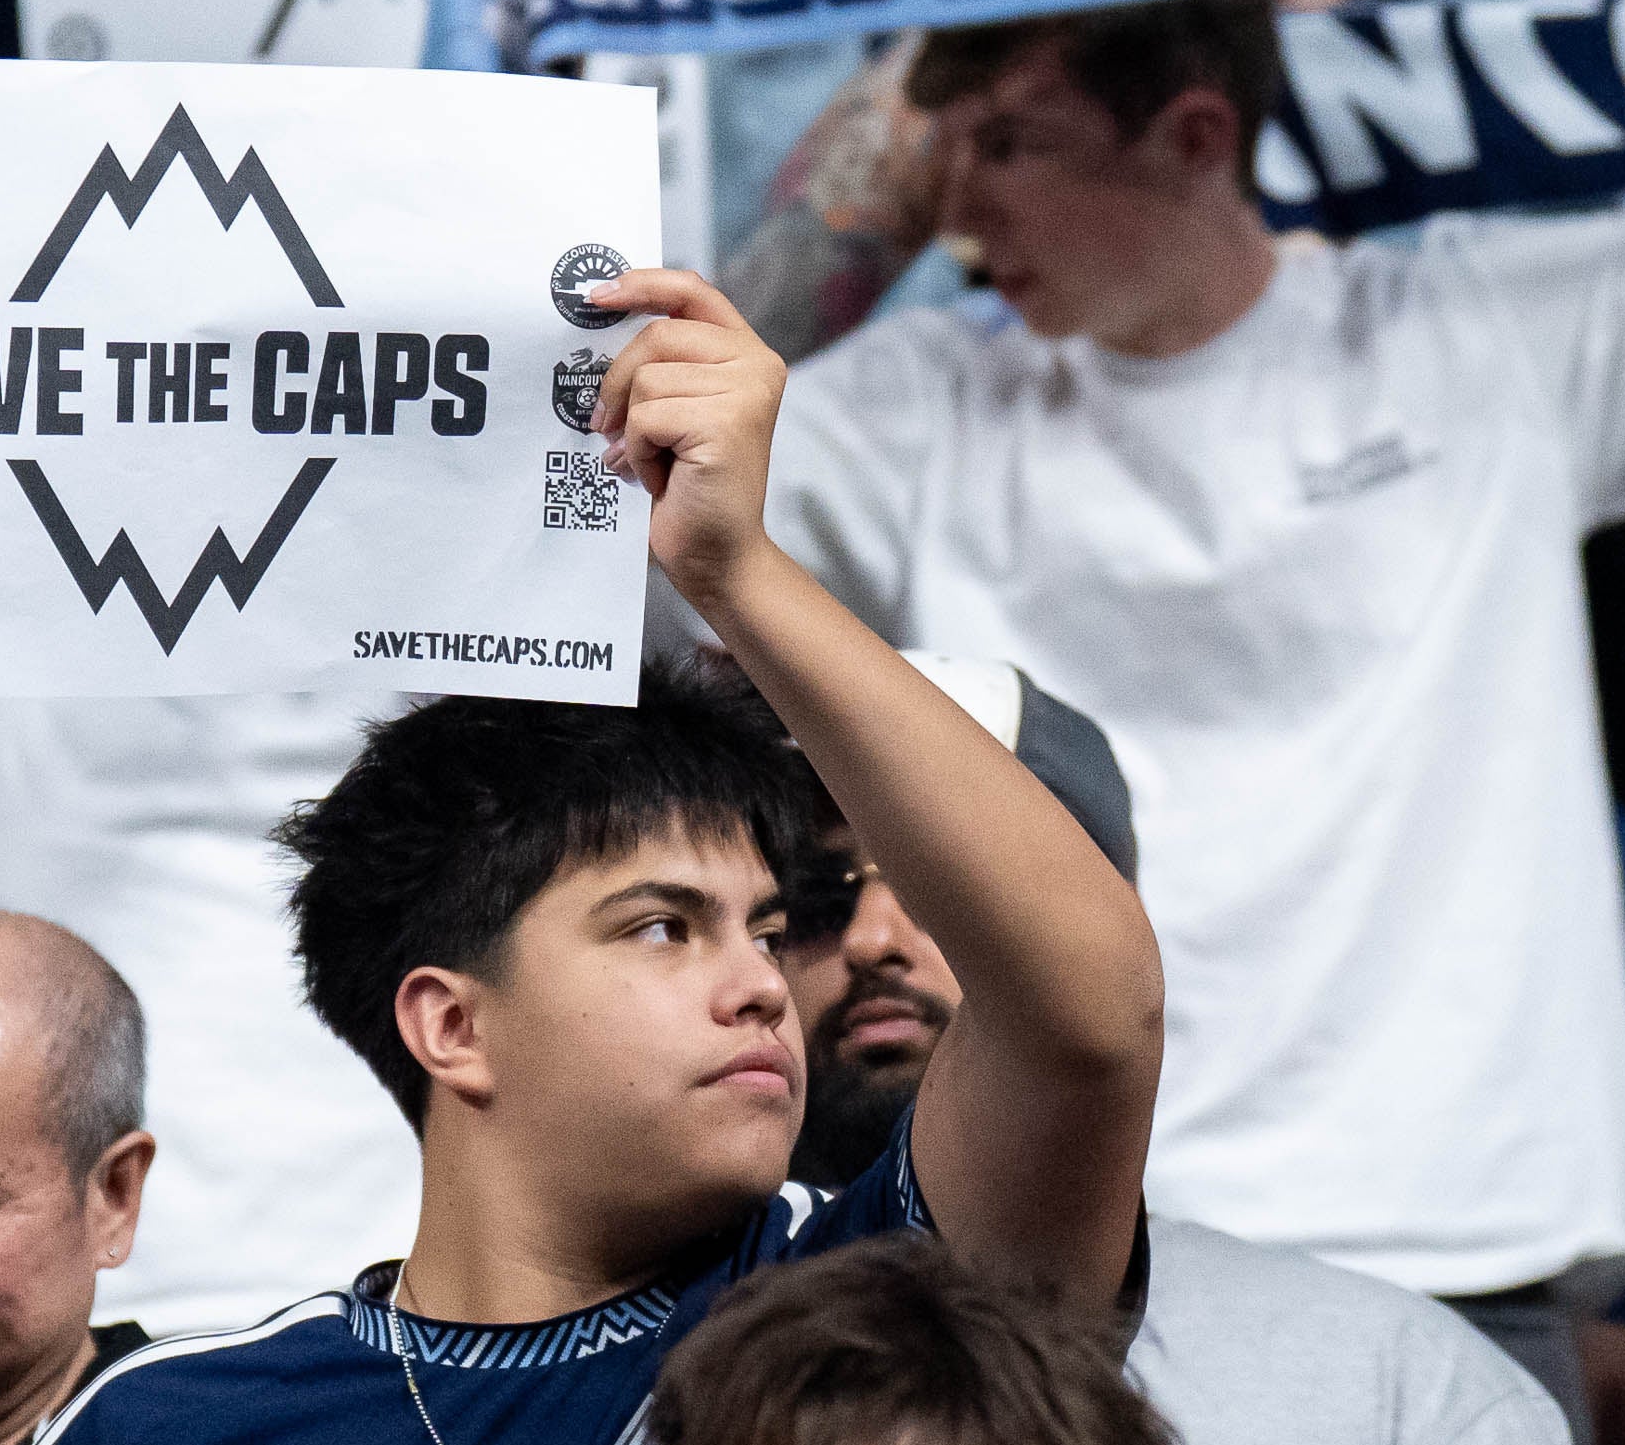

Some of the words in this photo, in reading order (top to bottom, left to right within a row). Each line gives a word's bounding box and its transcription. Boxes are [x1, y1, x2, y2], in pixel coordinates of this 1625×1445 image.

[553, 244, 605, 278] VANCOUVER
[106, 340, 230, 424] THE
[251, 330, 490, 437] CAPS
[557, 374, 603, 387] VANCOU
[352, 627, 613, 672] SAVETHECAPS.COM
